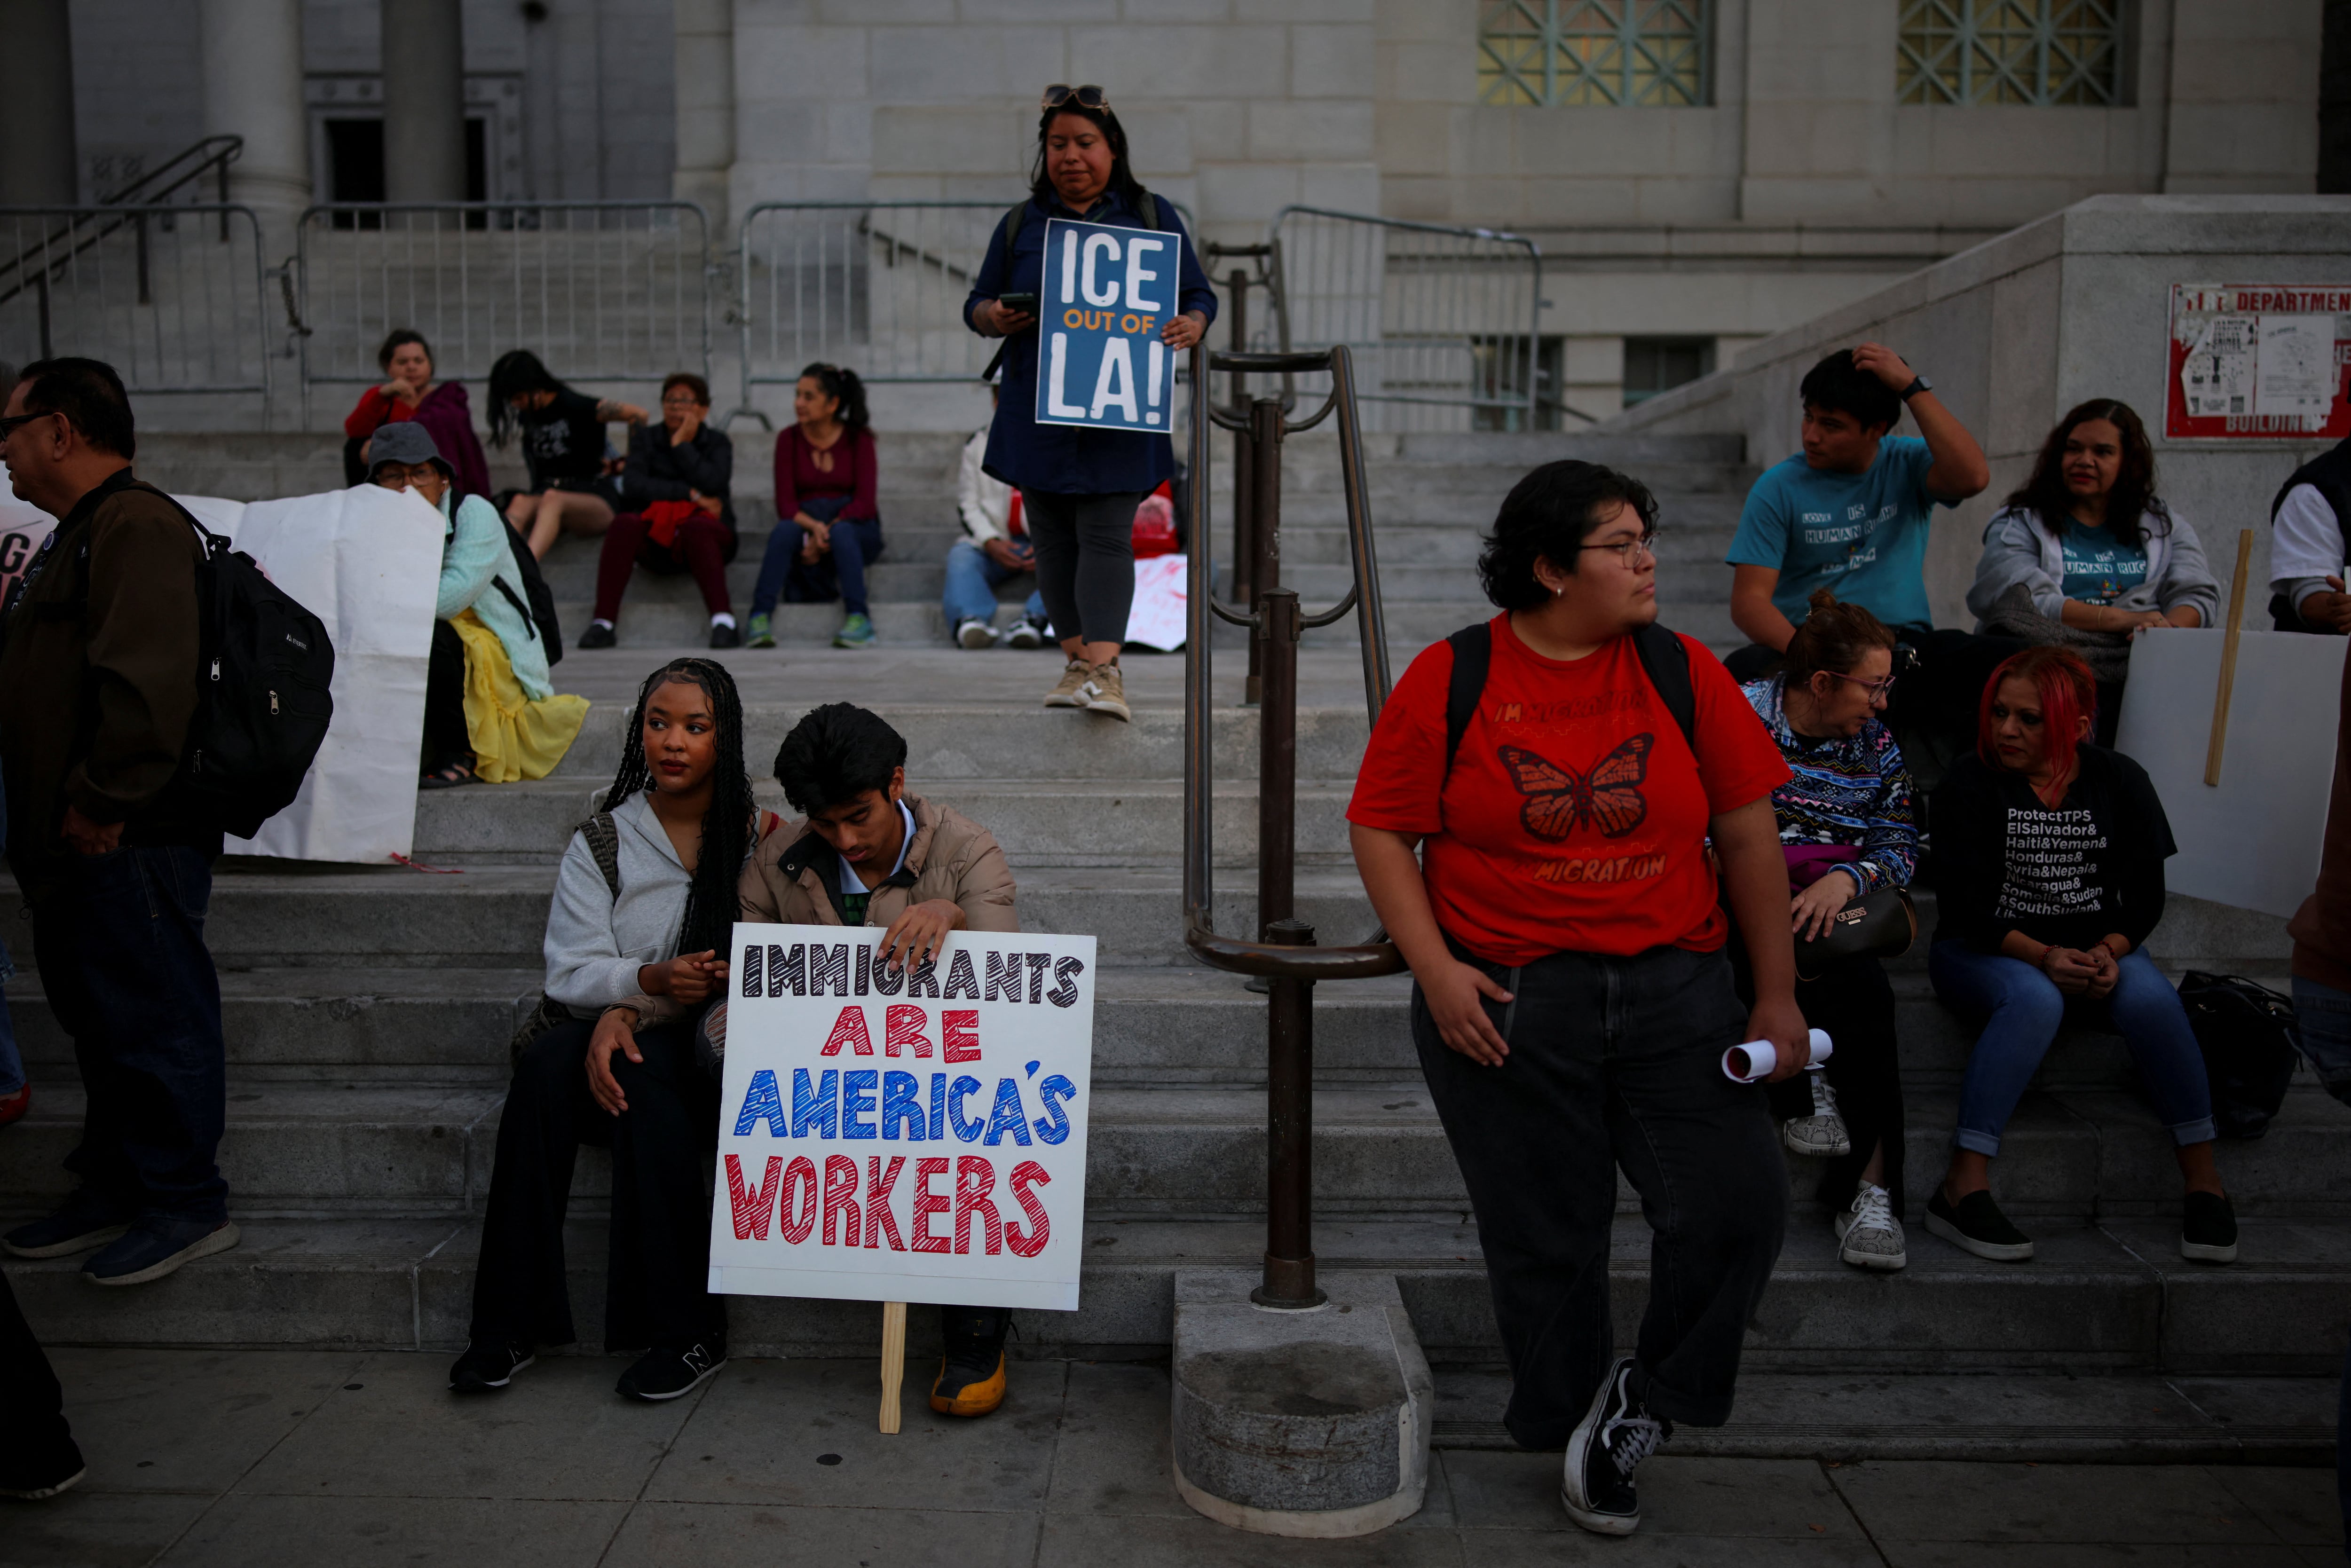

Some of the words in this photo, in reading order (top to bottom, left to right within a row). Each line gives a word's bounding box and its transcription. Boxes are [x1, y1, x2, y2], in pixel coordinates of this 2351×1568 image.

[1061, 229, 1164, 311] ICE
[1064, 309, 1115, 331] OUT
[1121, 314, 1155, 334] OF
[1048, 332, 1164, 425] LA!
[1802, 513, 1831, 523] LOVE
[1847, 504, 1866, 520] IS
[1805, 525, 1861, 544] HUMAN
[293, 638, 307, 651] EVEREST
[2007, 822, 2097, 836] ElSalvador&
[2006, 836, 2107, 850] Haiti&Yemen&
[2005, 850, 2083, 864] Honduras&
[2005, 862, 2097, 878] Syria&Nepal&
[1836, 906, 1867, 922] GUESS
[742, 944, 1084, 1008] IMMIGRANTS
[820, 1004, 982, 1064] ARE
[734, 1060, 1076, 1146] AMERICA'S
[724, 1154, 1051, 1257] WORKERS
